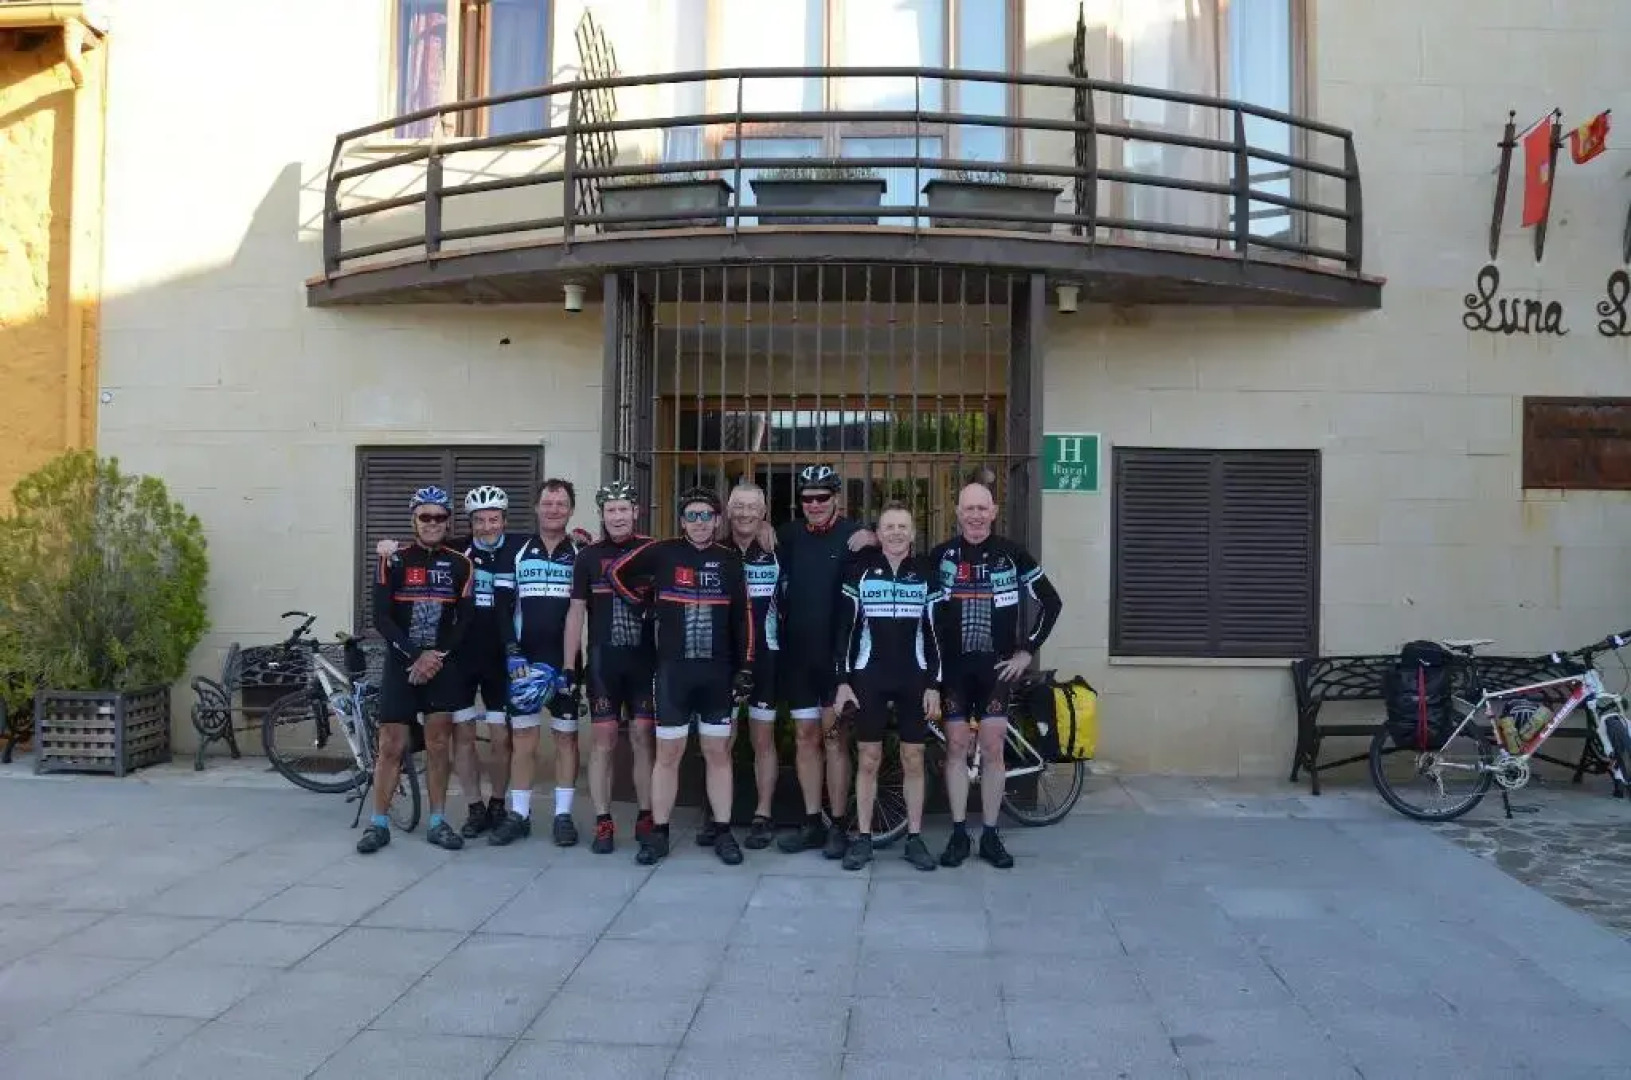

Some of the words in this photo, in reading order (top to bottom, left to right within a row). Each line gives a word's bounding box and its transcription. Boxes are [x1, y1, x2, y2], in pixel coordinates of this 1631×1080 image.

[1463, 265, 1569, 335] Luna
[1057, 437, 1083, 463] H
[426, 569, 453, 585] TFS
[518, 568, 542, 579] LOST
[544, 568, 572, 579] VELO
[696, 571, 721, 587] TFS
[746, 571, 775, 579] ELOS
[971, 563, 990, 579] TF
[862, 589, 888, 598] LOST
[890, 588, 924, 599] VELOS
